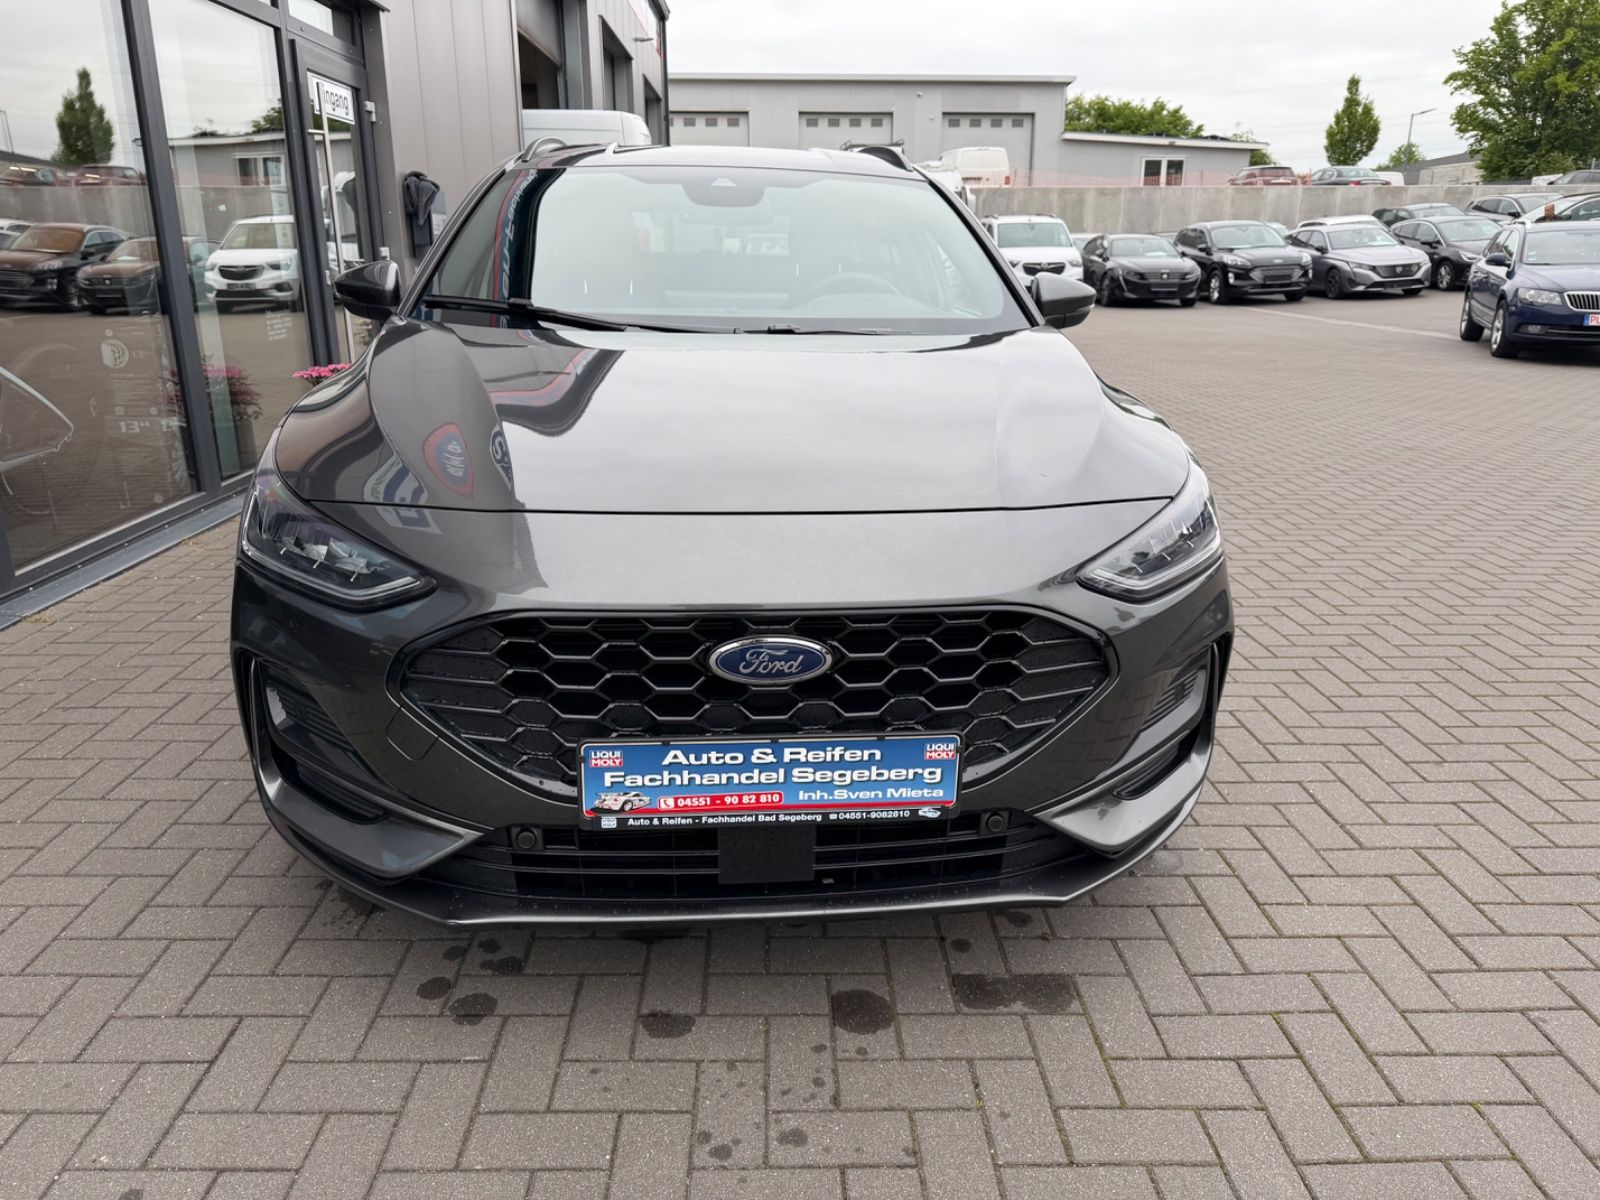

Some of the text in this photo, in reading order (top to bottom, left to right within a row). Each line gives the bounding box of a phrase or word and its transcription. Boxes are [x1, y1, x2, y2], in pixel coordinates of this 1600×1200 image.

[739, 648, 804, 674] Ford
[926, 743, 954, 752] LIQUI
[591, 750, 621, 759] LIQUI
[661, 746, 881, 765] Auto & Reifen
[926, 751, 955, 760] MOLY
[591, 758, 622, 768] MOLY
[604, 765, 942, 788] Fachhandel Segeberg
[886, 787, 944, 798] Mieta
[677, 796, 711, 808] 04551
[724, 795, 739, 805] 90
[742, 794, 757, 804] 82
[760, 793, 780, 803] 810
[627, 818, 650, 826] Auto
[662, 816, 692, 825] Reifen
[702, 814, 755, 824] Fachhandel
[758, 814, 776, 822] Bad
[778, 812, 822, 822] Segeberg
[838, 809, 910, 820] 04551-9082810
